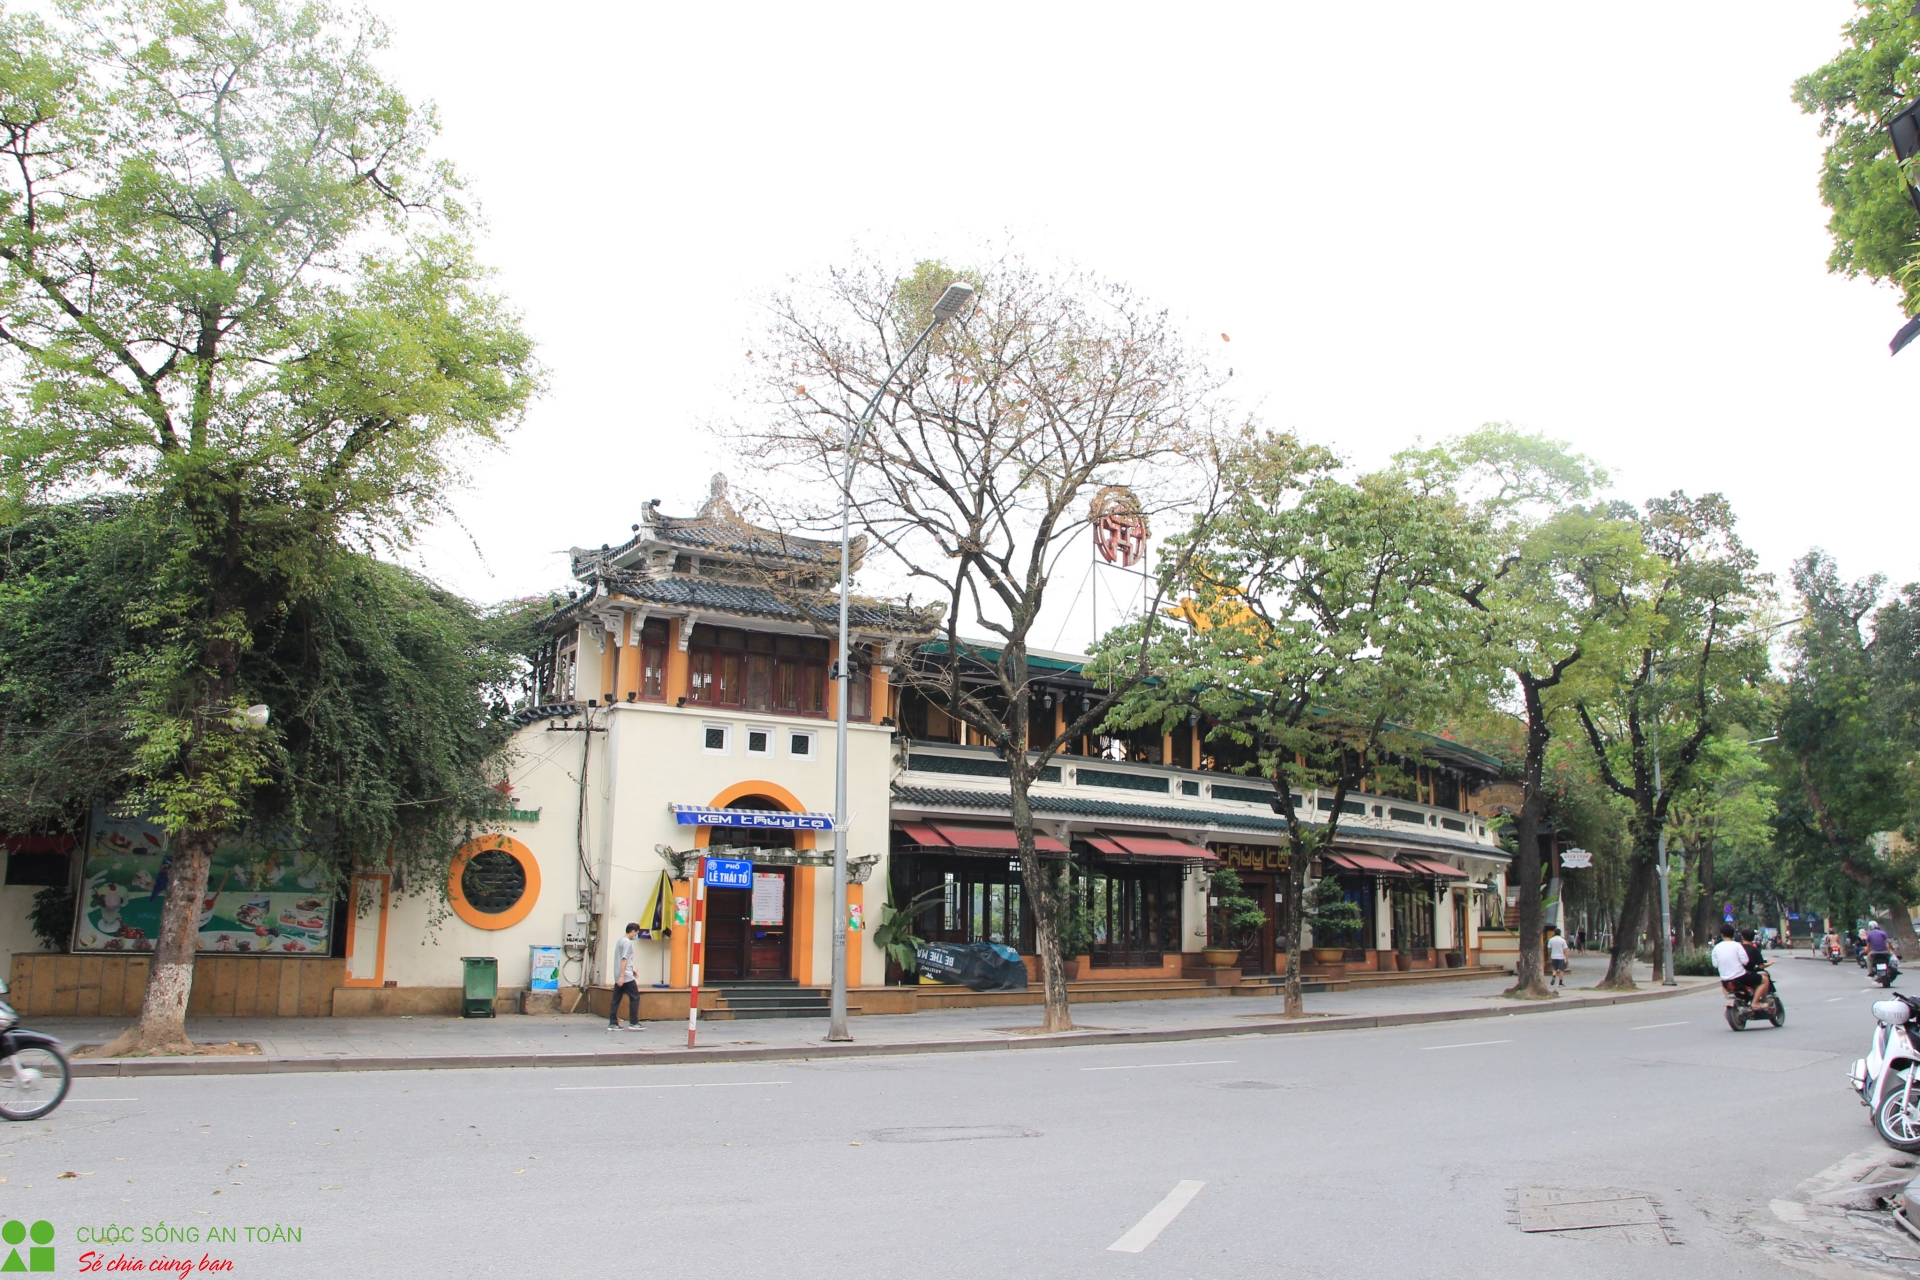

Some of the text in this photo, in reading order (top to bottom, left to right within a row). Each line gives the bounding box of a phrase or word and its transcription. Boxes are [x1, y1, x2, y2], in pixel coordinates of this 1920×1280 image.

[698, 814, 732, 824] KEM
[725, 861, 741, 870] PHỐ
[708, 870, 749, 884] LÊ THÁI TỔ
[929, 951, 944, 964] THE
[945, 955, 955, 967] BE
